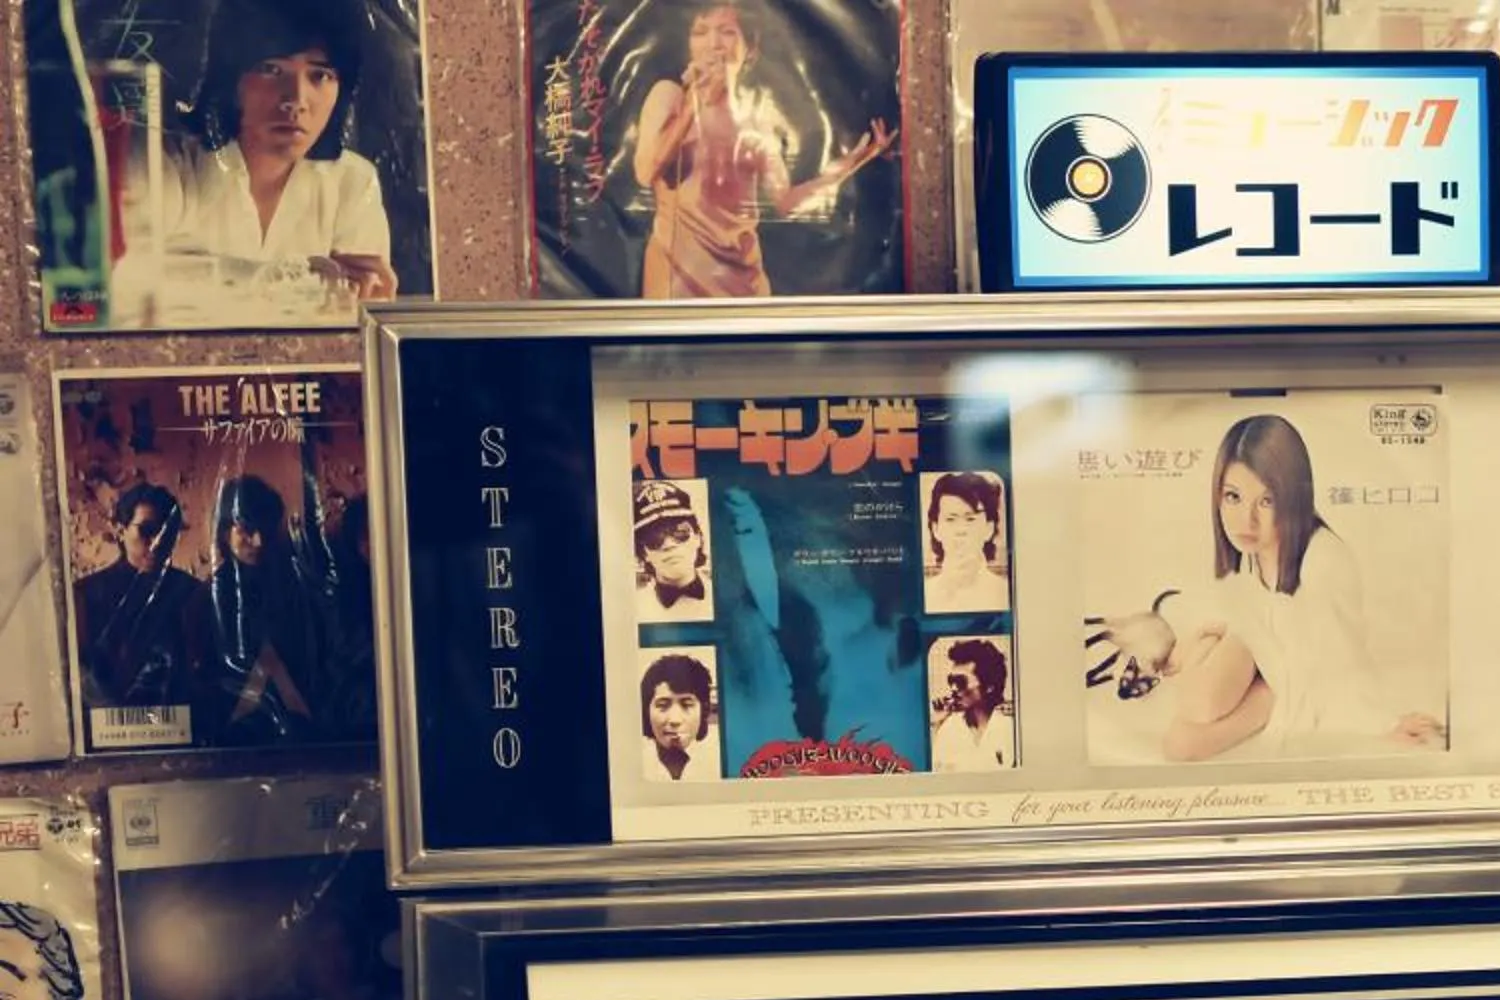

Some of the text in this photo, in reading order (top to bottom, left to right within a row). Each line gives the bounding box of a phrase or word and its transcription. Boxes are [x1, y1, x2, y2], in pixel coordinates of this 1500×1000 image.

[1168, 181, 1458, 256] レコード
[178, 382, 321, 416] THE ALFEE
[480, 426, 521, 768] STEREO
[749, 801, 989, 827] PRESENTING
[1011, 793, 1042, 823] for
[1101, 791, 1187, 816] listening
[1297, 787, 1375, 806] THE
[1388, 782, 1473, 803] BEST
